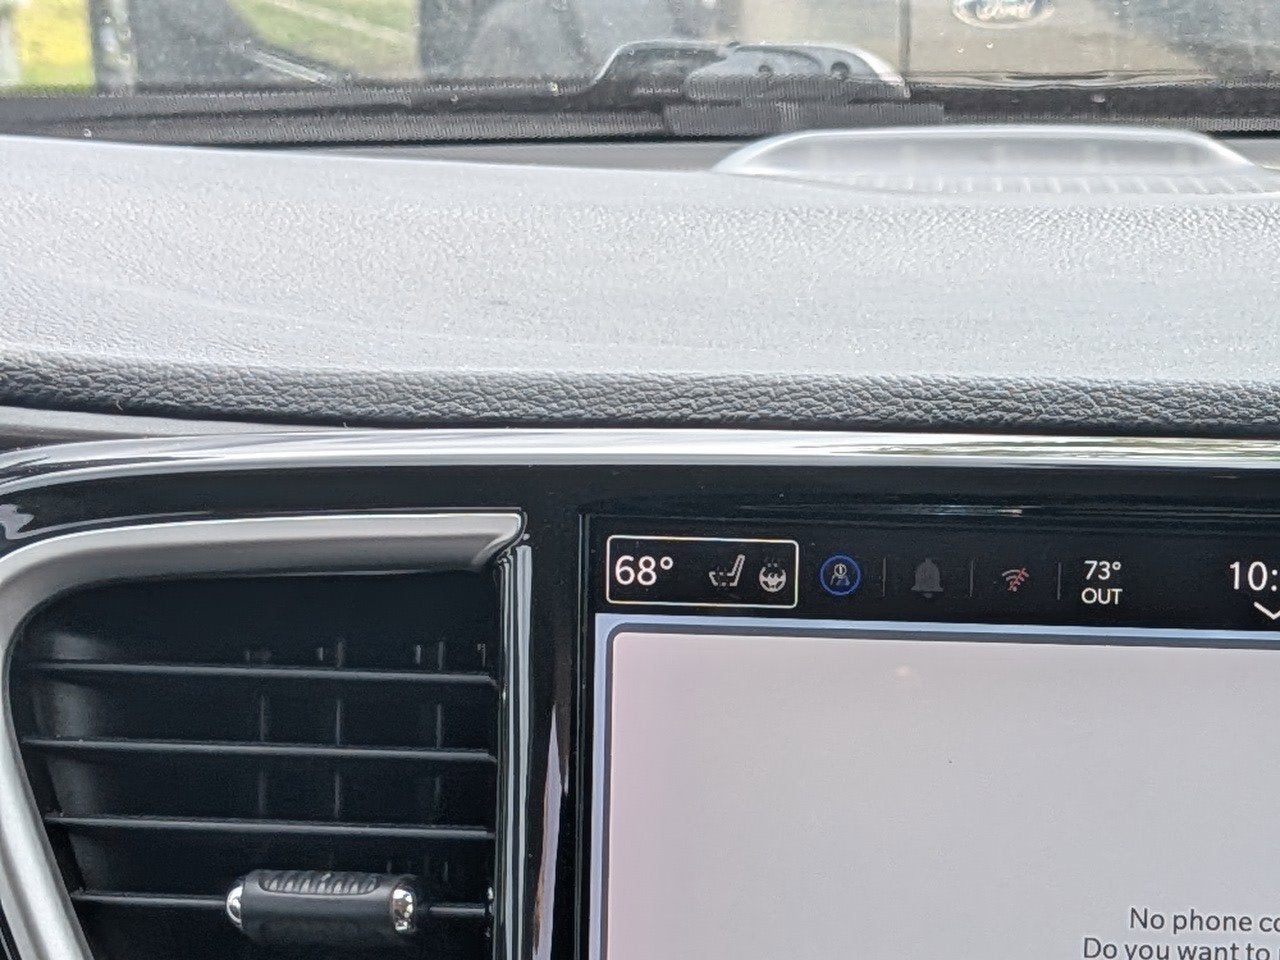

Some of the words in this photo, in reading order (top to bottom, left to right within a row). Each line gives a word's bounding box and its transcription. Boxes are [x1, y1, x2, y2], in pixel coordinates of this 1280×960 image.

[1081, 587, 1124, 606] OUT
[1129, 907, 1166, 931] No
[1173, 909, 1253, 935] phone
[1083, 937, 1118, 960] Do
